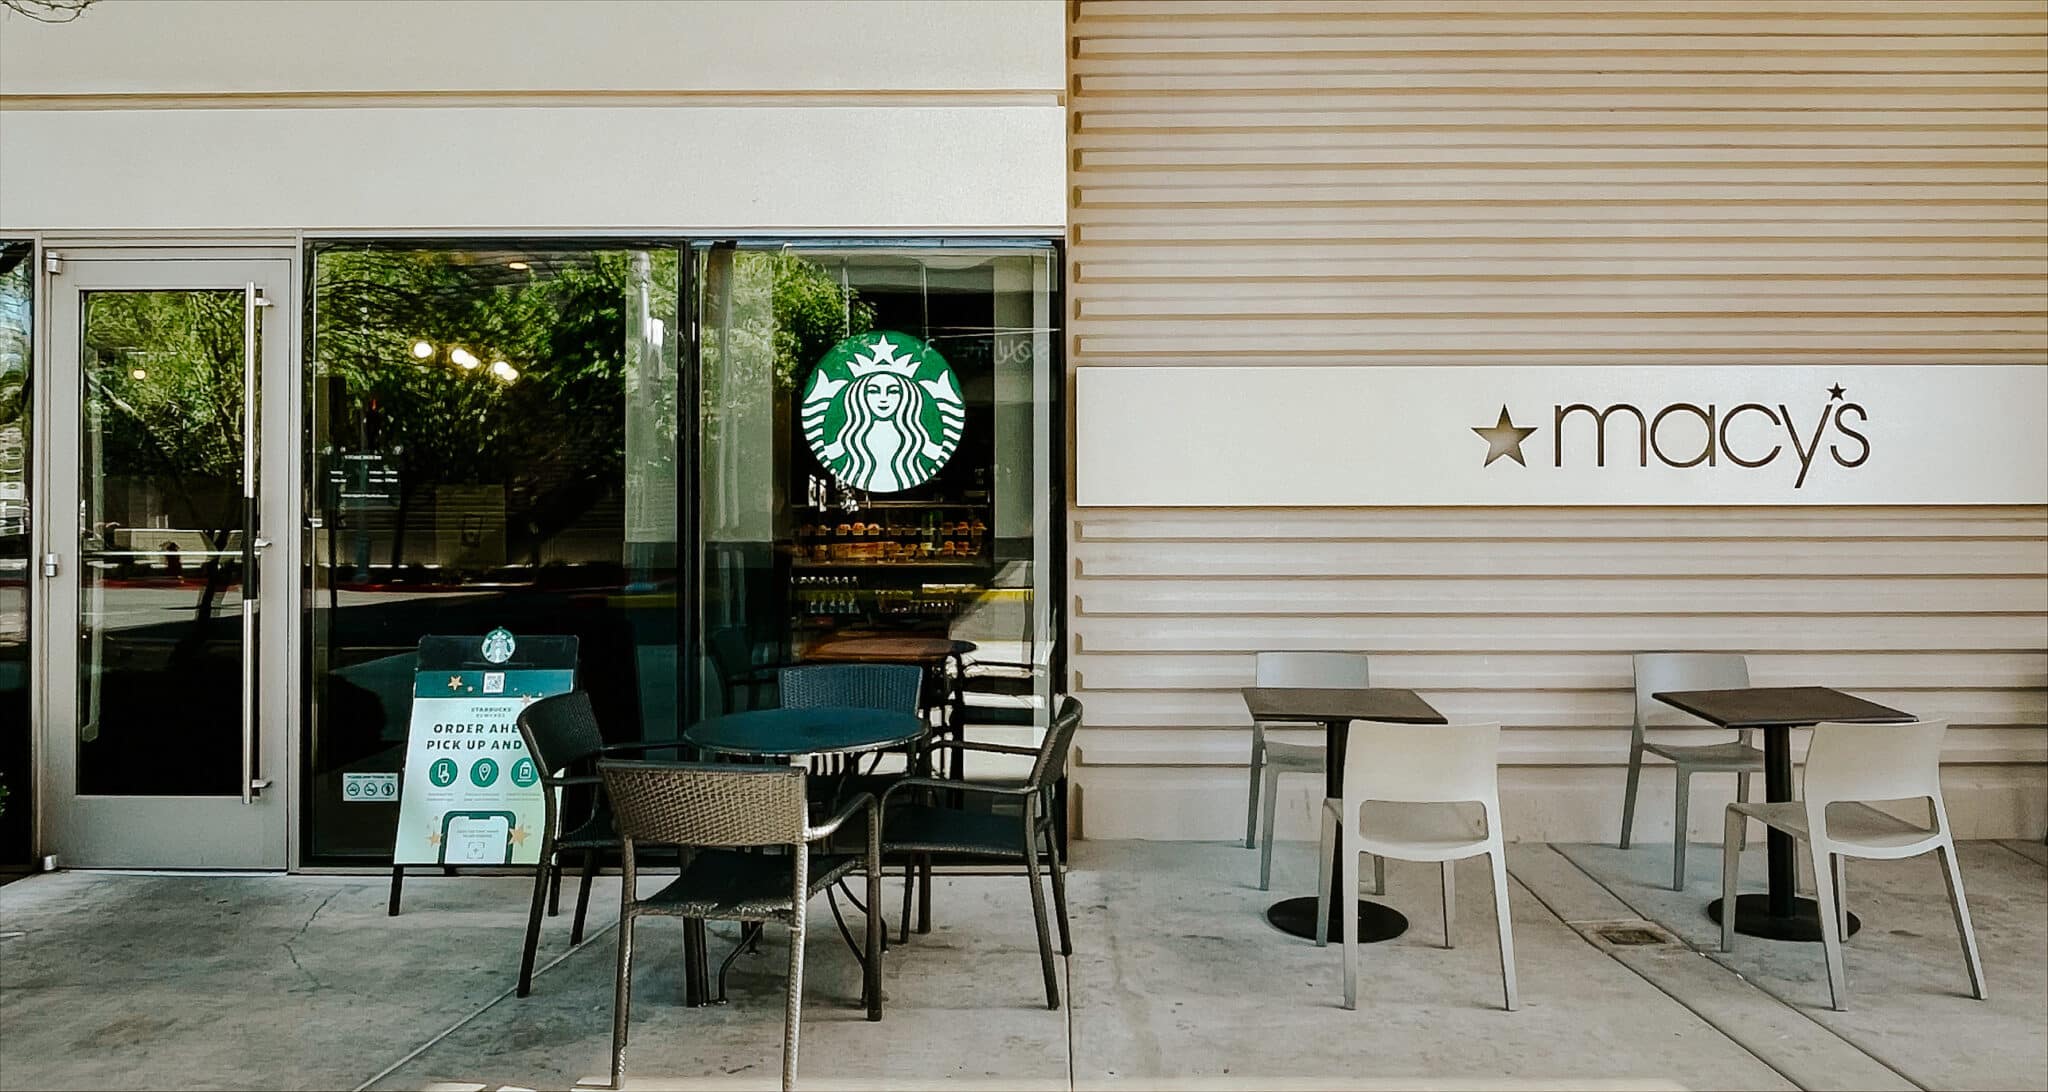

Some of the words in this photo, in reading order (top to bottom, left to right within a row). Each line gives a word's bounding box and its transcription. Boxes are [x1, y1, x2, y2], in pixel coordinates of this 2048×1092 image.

[1554, 382, 1871, 489] macy's
[433, 723, 484, 734] ORDER
[489, 723, 518, 734] AHE
[426, 740, 461, 750] PICK
[467, 740, 486, 750] UP
[491, 740, 522, 750] AND
